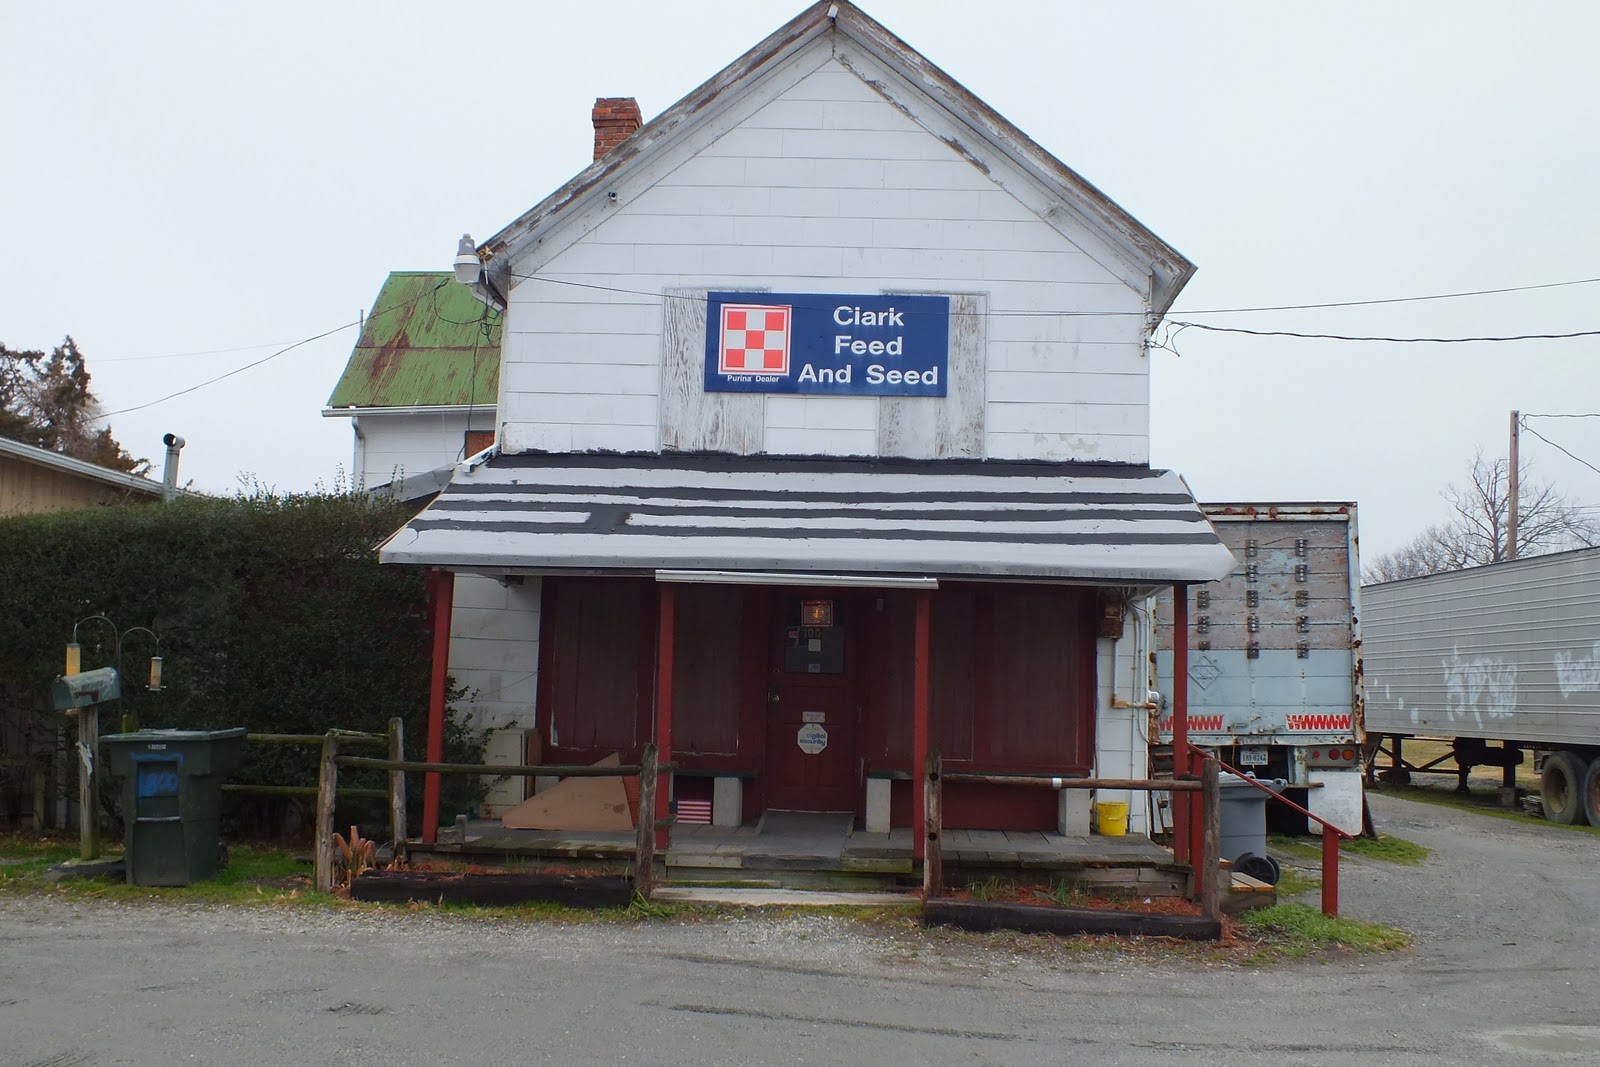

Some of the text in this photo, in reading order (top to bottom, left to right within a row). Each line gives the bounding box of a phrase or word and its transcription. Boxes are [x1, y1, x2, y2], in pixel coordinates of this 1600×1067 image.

[833, 306, 904, 326] Clark
[834, 335, 903, 355] Feed
[727, 374, 780, 383] Purina Dealer
[797, 363, 938, 385] And Seed
